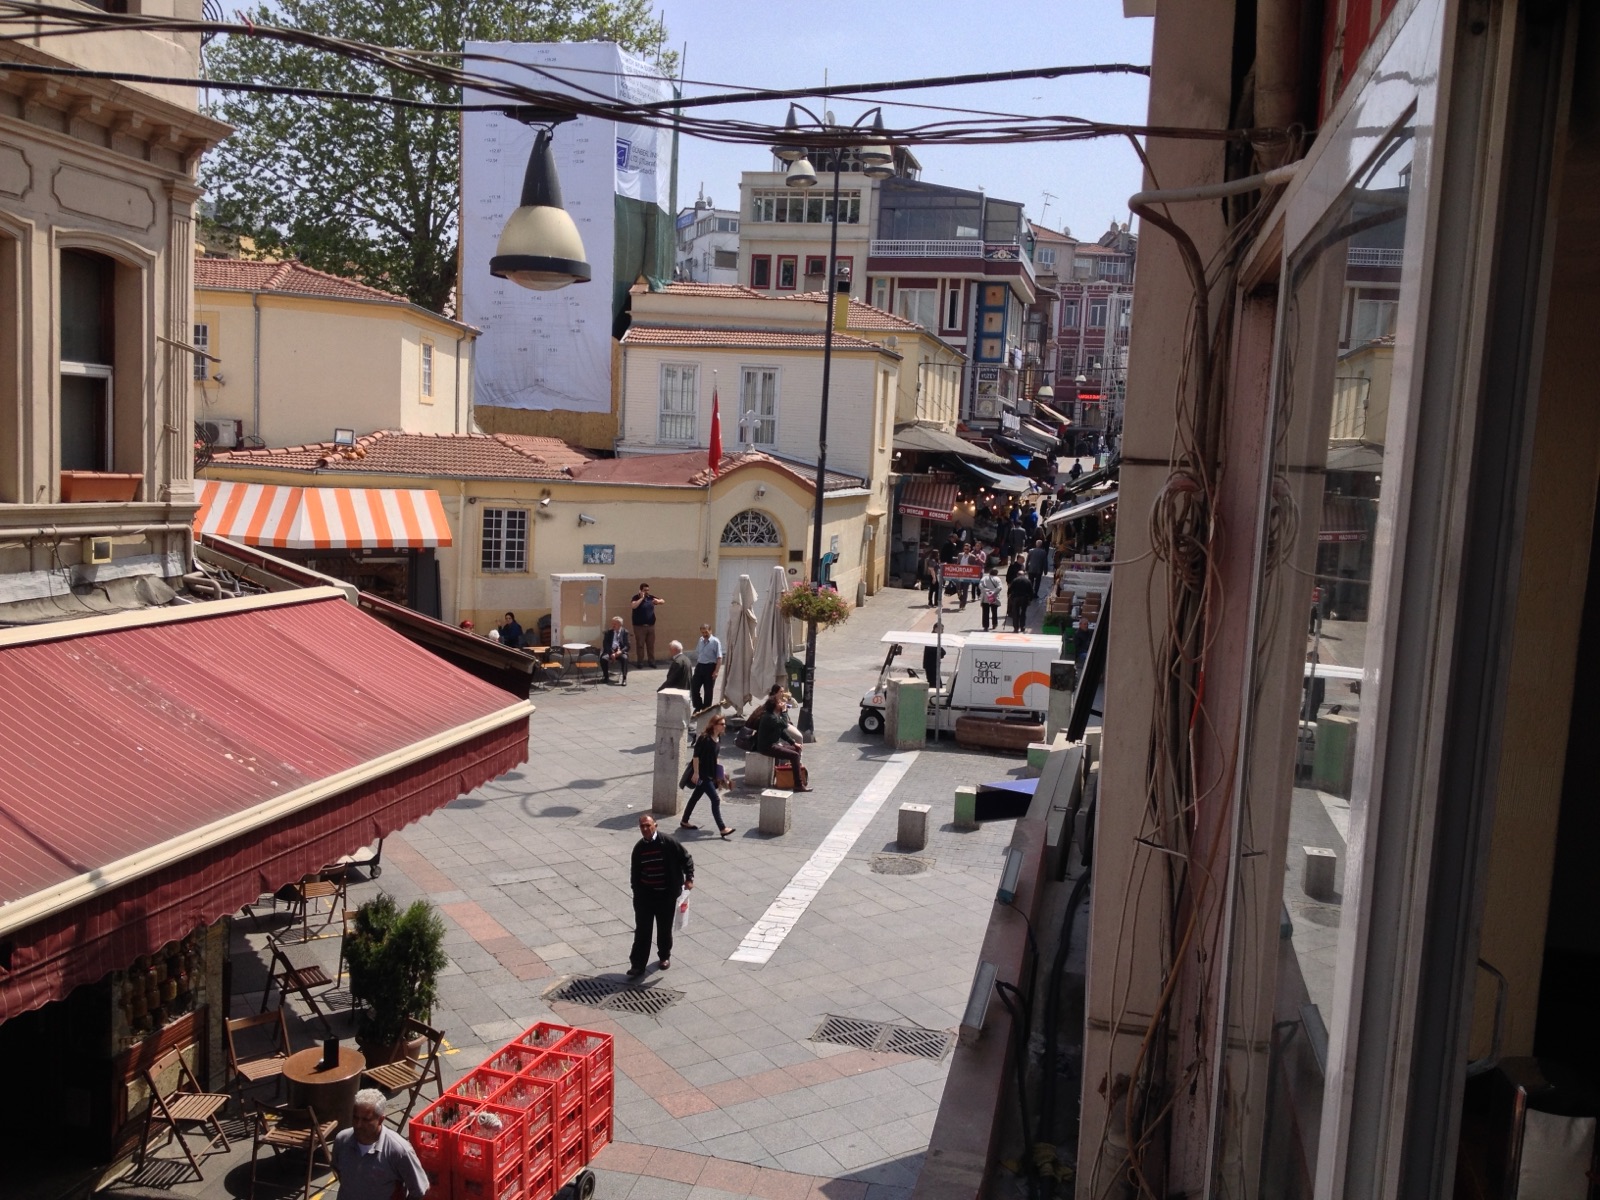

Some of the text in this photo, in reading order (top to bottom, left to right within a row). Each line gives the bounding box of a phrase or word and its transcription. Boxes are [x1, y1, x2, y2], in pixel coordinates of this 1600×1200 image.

[928, 511, 949, 521] KOKOREÇ
[975, 659, 1001, 670] beyaz
[872, 695, 883, 704] 03
